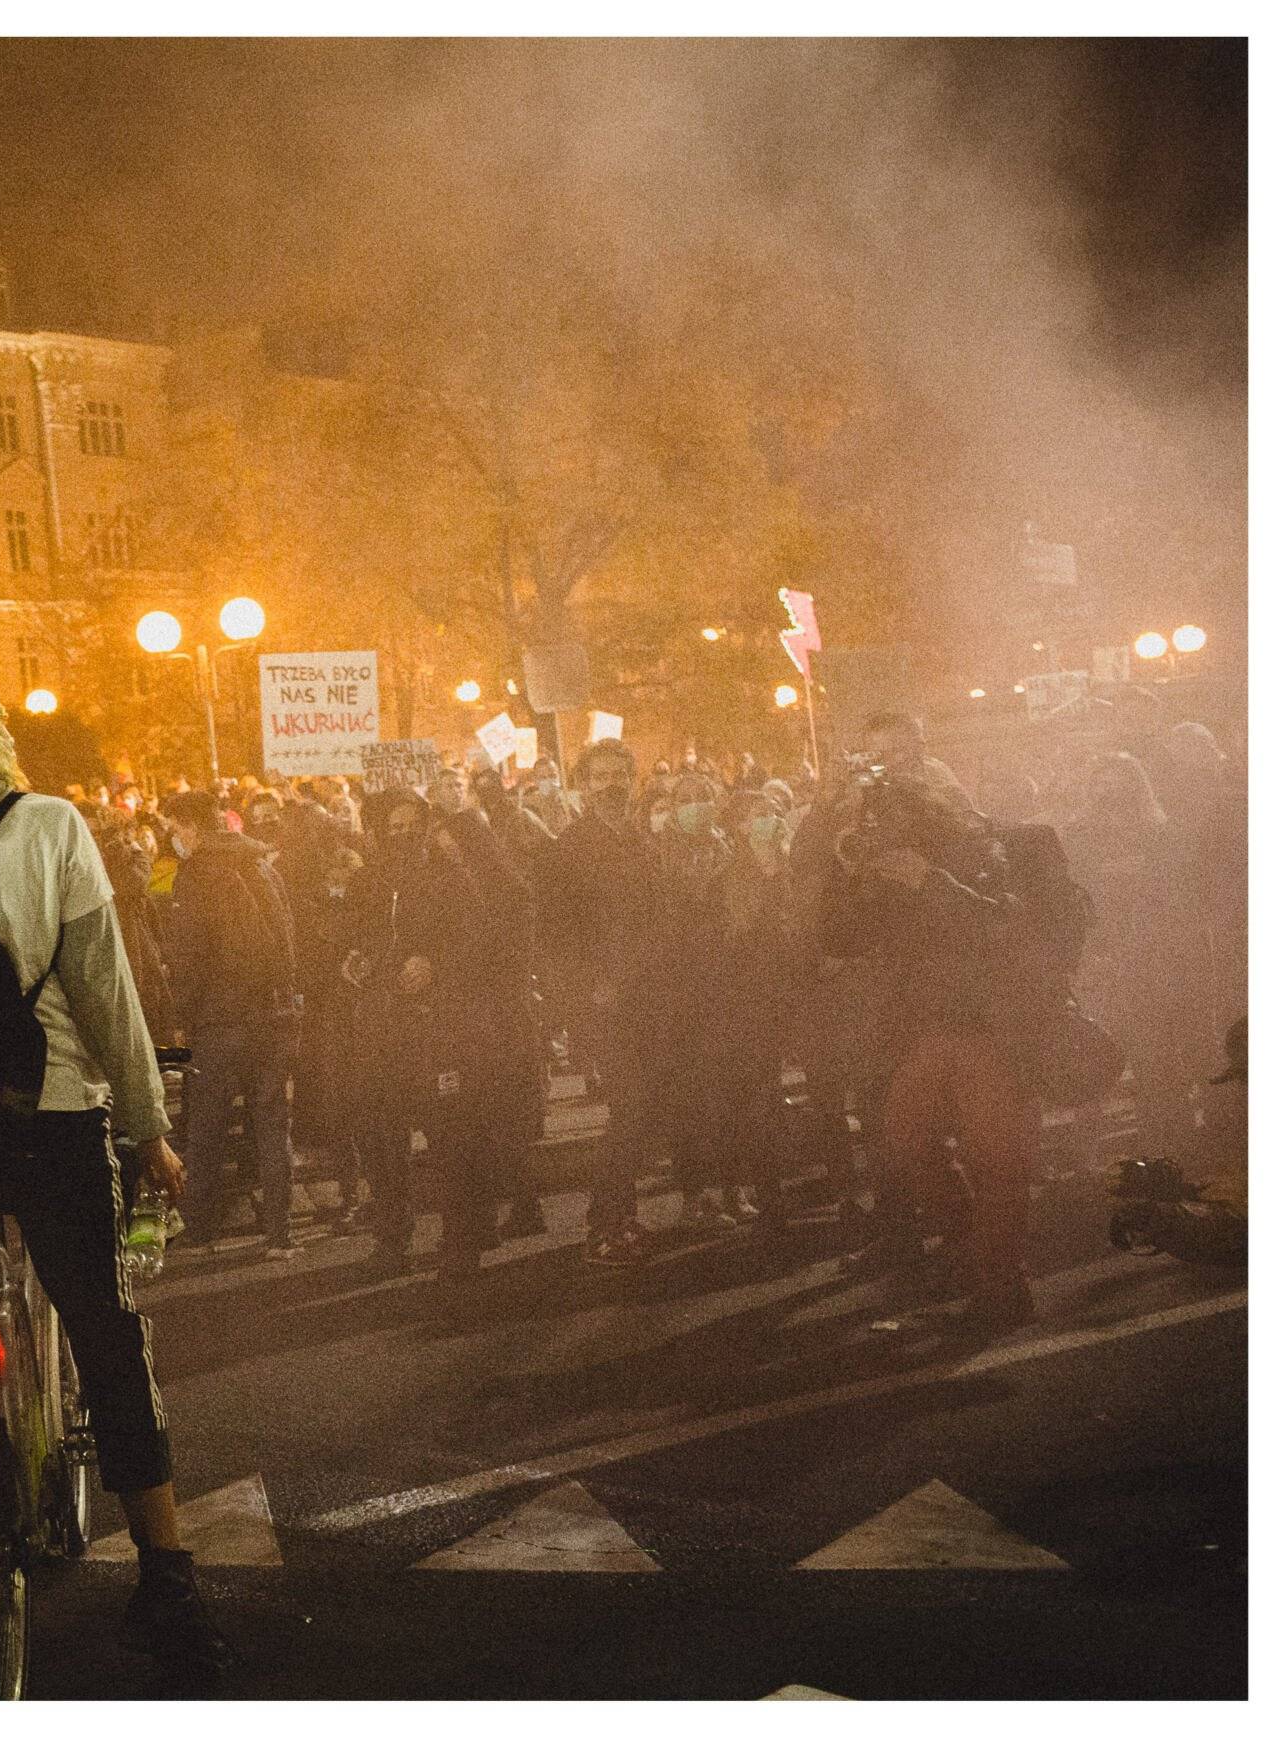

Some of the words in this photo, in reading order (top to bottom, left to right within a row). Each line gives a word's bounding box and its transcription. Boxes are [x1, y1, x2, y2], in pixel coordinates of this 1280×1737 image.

[267, 665, 326, 682] TRZEBA
[333, 666, 371, 681] BYŁO
[280, 687, 316, 703] NAS
[327, 685, 357, 704] NIE
